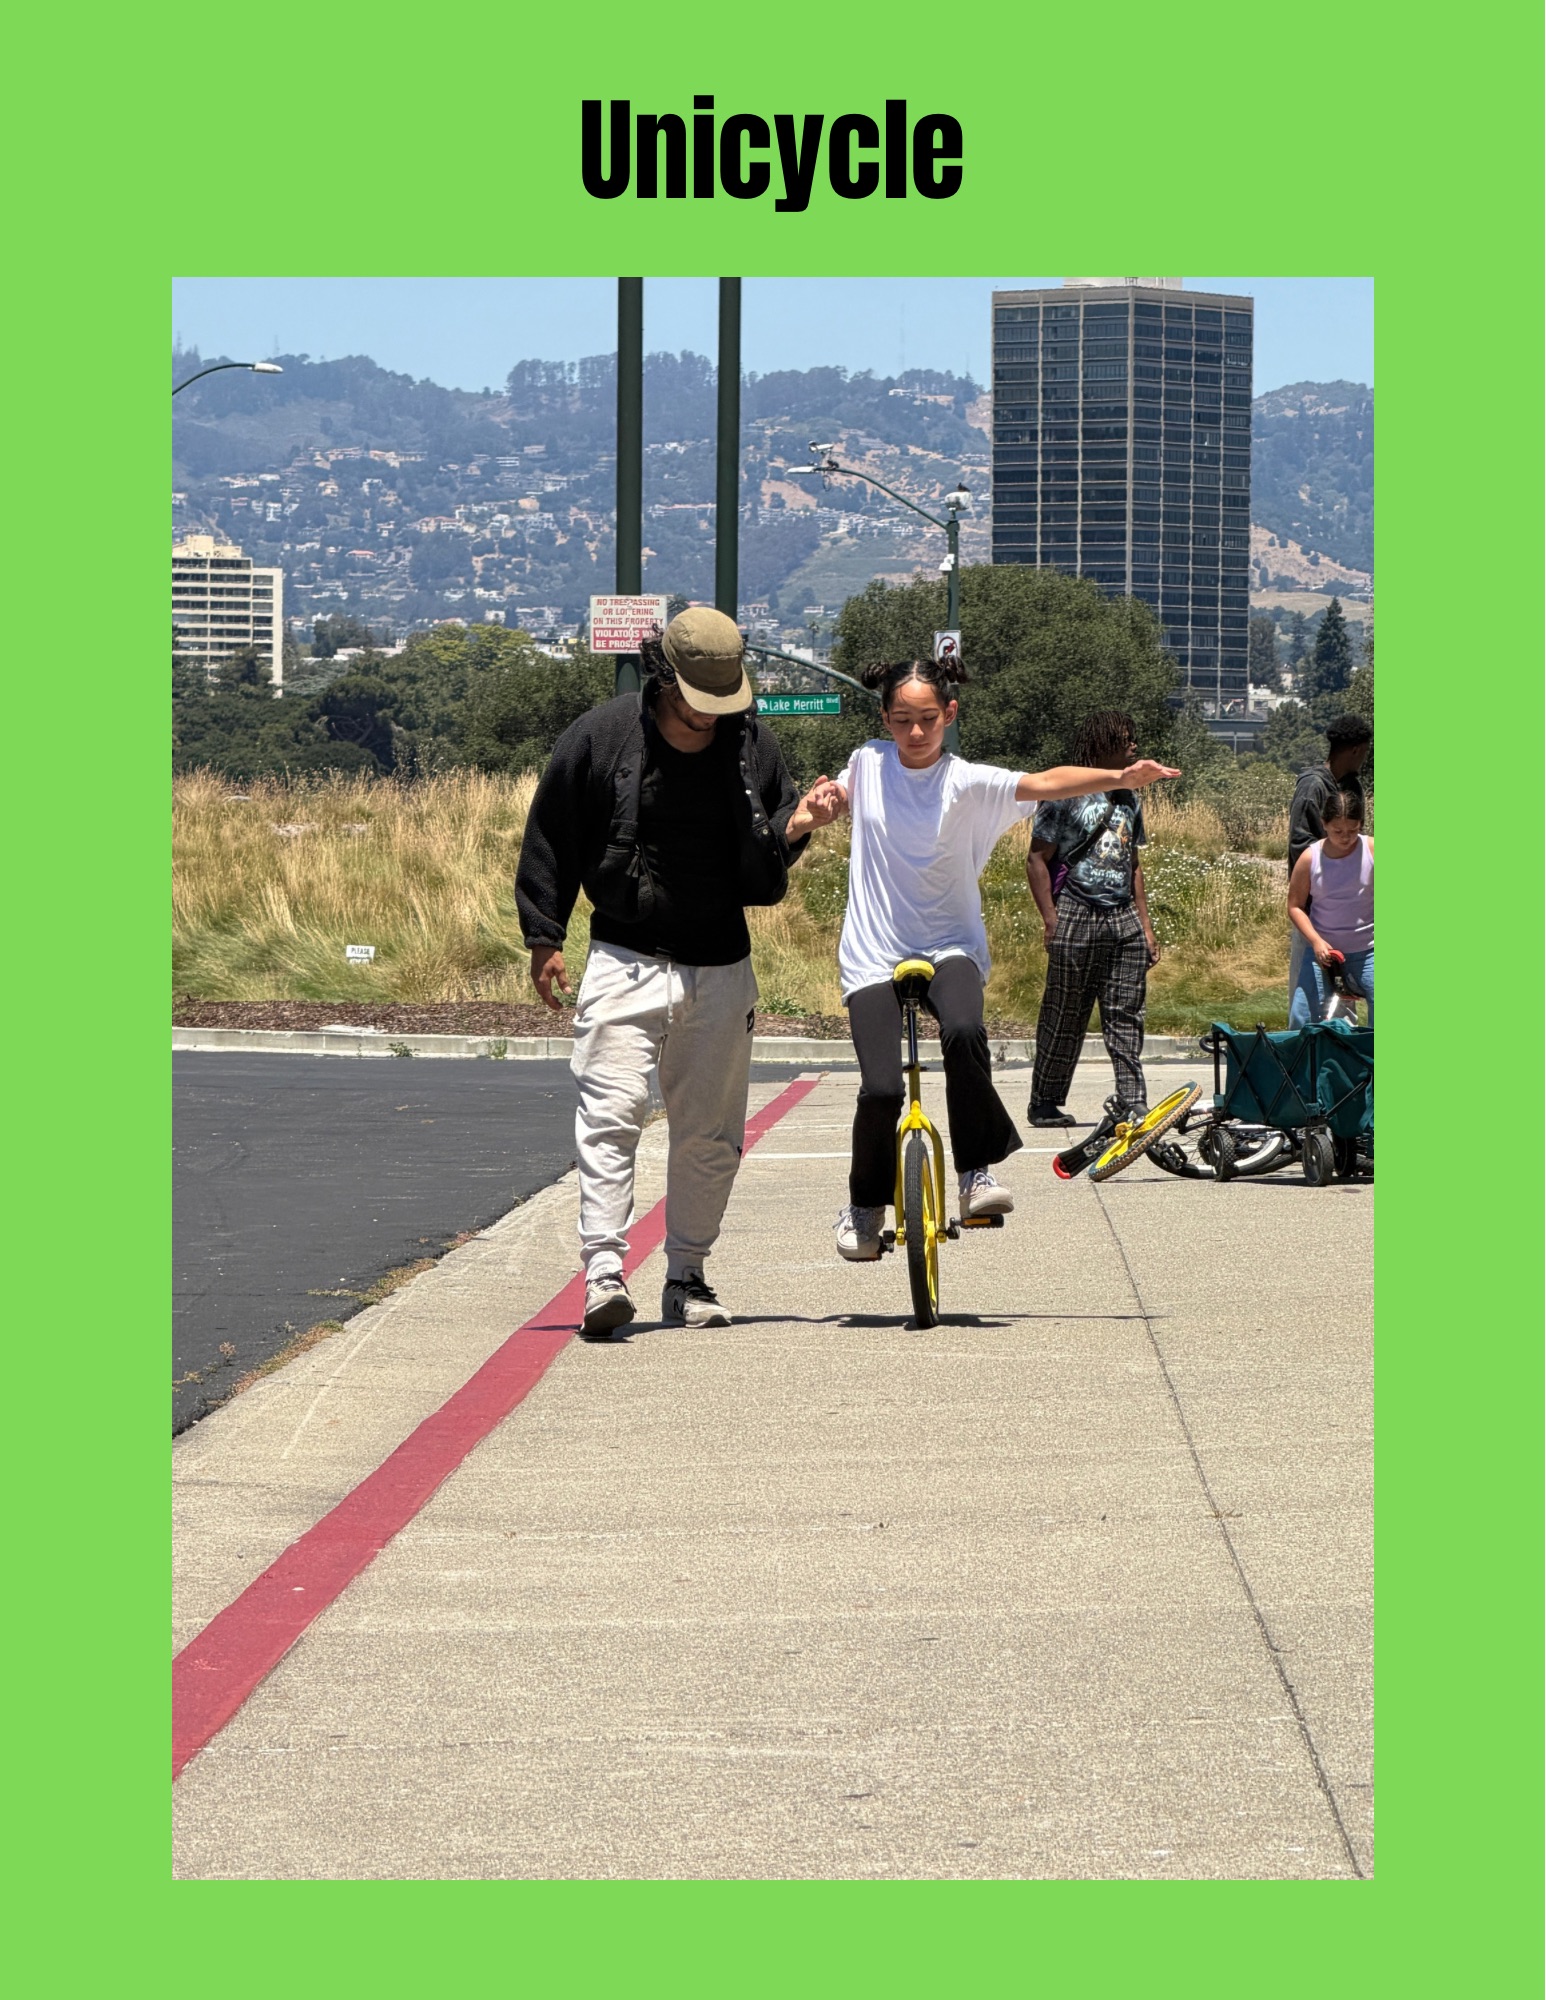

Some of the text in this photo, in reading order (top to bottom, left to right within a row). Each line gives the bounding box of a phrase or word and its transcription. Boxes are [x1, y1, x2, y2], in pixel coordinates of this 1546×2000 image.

[603, 608, 654, 616] OR LOIERING
[593, 617, 663, 625] ON THIS PROPERTY
[595, 629, 640, 638] VIOLATORS
[595, 640, 606, 648] BE
[769, 699, 790, 711] Lake
[793, 698, 824, 711] Merritt
[351, 947, 370, 955] PLEASE
